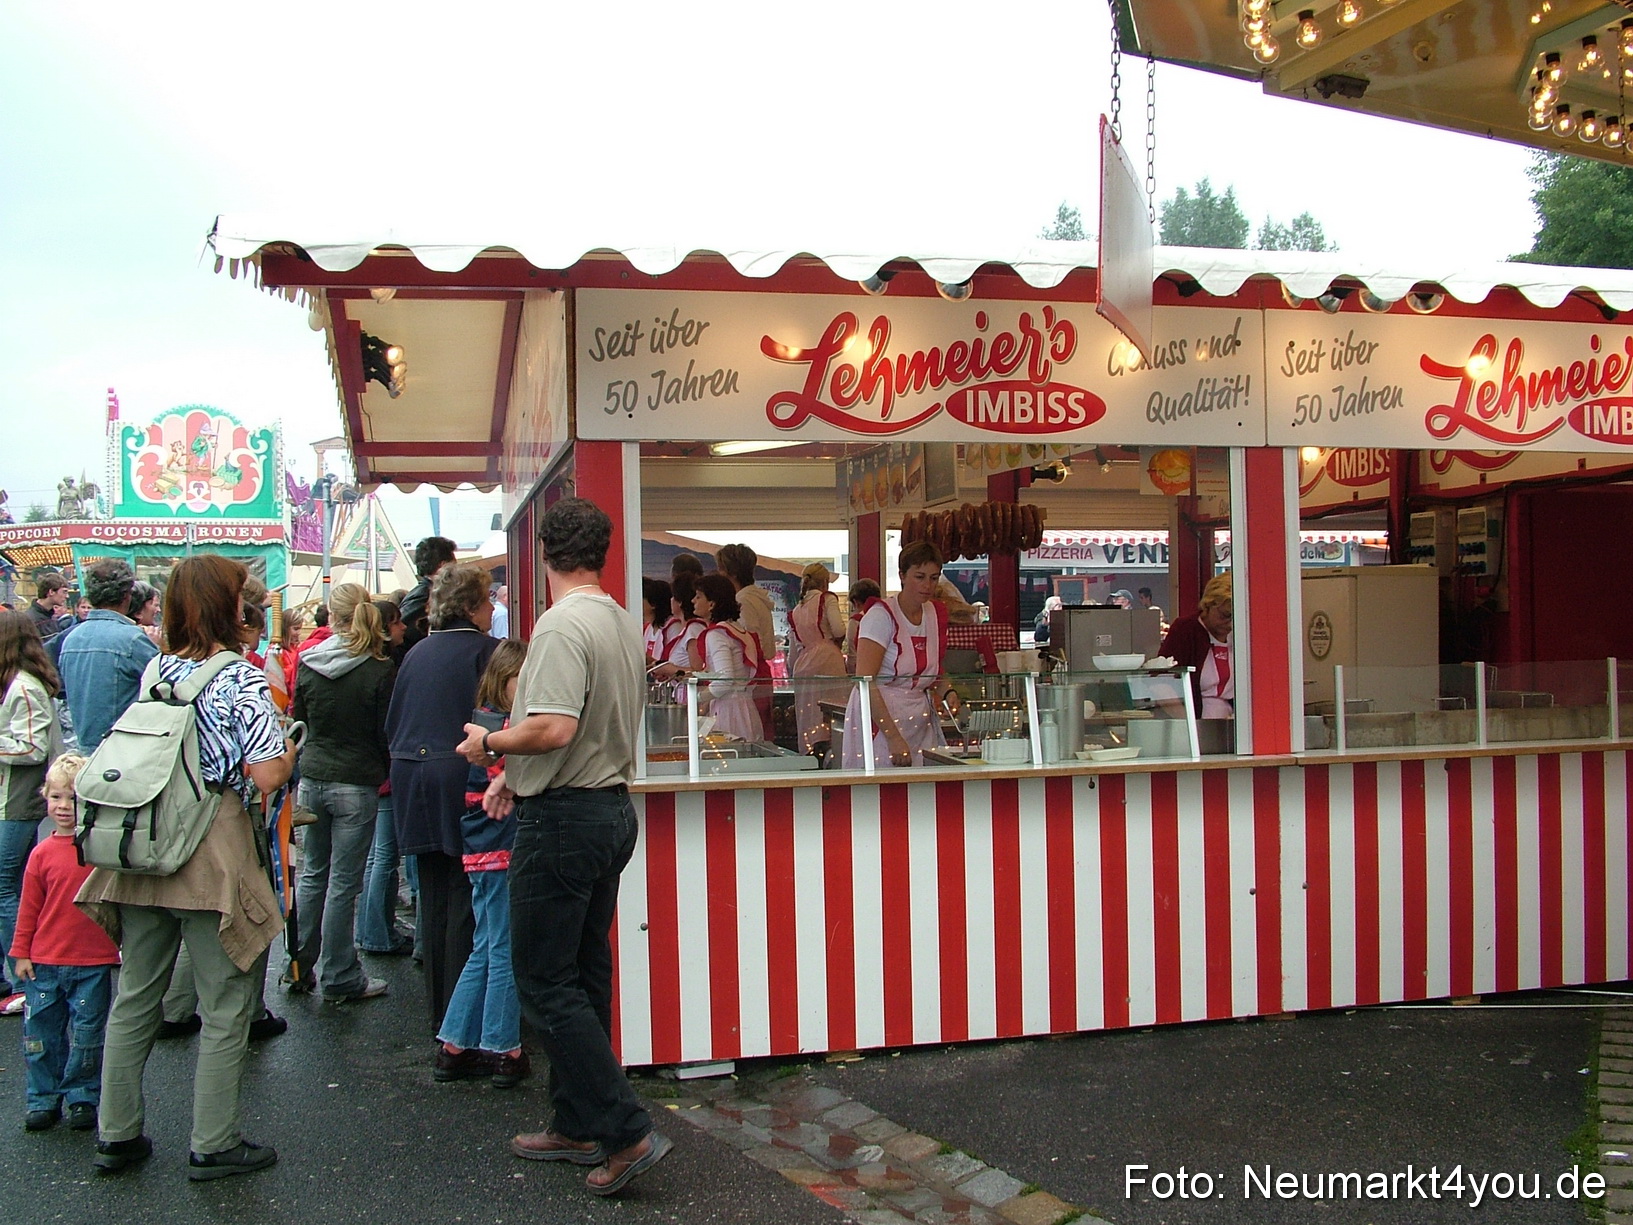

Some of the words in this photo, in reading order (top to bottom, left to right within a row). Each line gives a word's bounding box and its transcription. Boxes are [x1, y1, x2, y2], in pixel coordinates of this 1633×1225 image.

[589, 319, 645, 362] Seit
[650, 307, 711, 354] über
[1196, 317, 1241, 363] und
[1281, 339, 1325, 378] Seit
[1331, 329, 1379, 372] über
[603, 379, 639, 415] 50
[647, 358, 740, 411] Jahren
[760, 305, 1078, 434] Lehmeier's
[966, 390, 1087, 424] IMBISS
[1146, 374, 1251, 425] Qualität!
[1294, 393, 1322, 426] 50
[1329, 376, 1404, 422] Jahren
[0, 526, 61, 540] POPCORN
[91, 526, 263, 537] COCOSMARONEN
[1027, 547, 1093, 560] PIZZERIA
